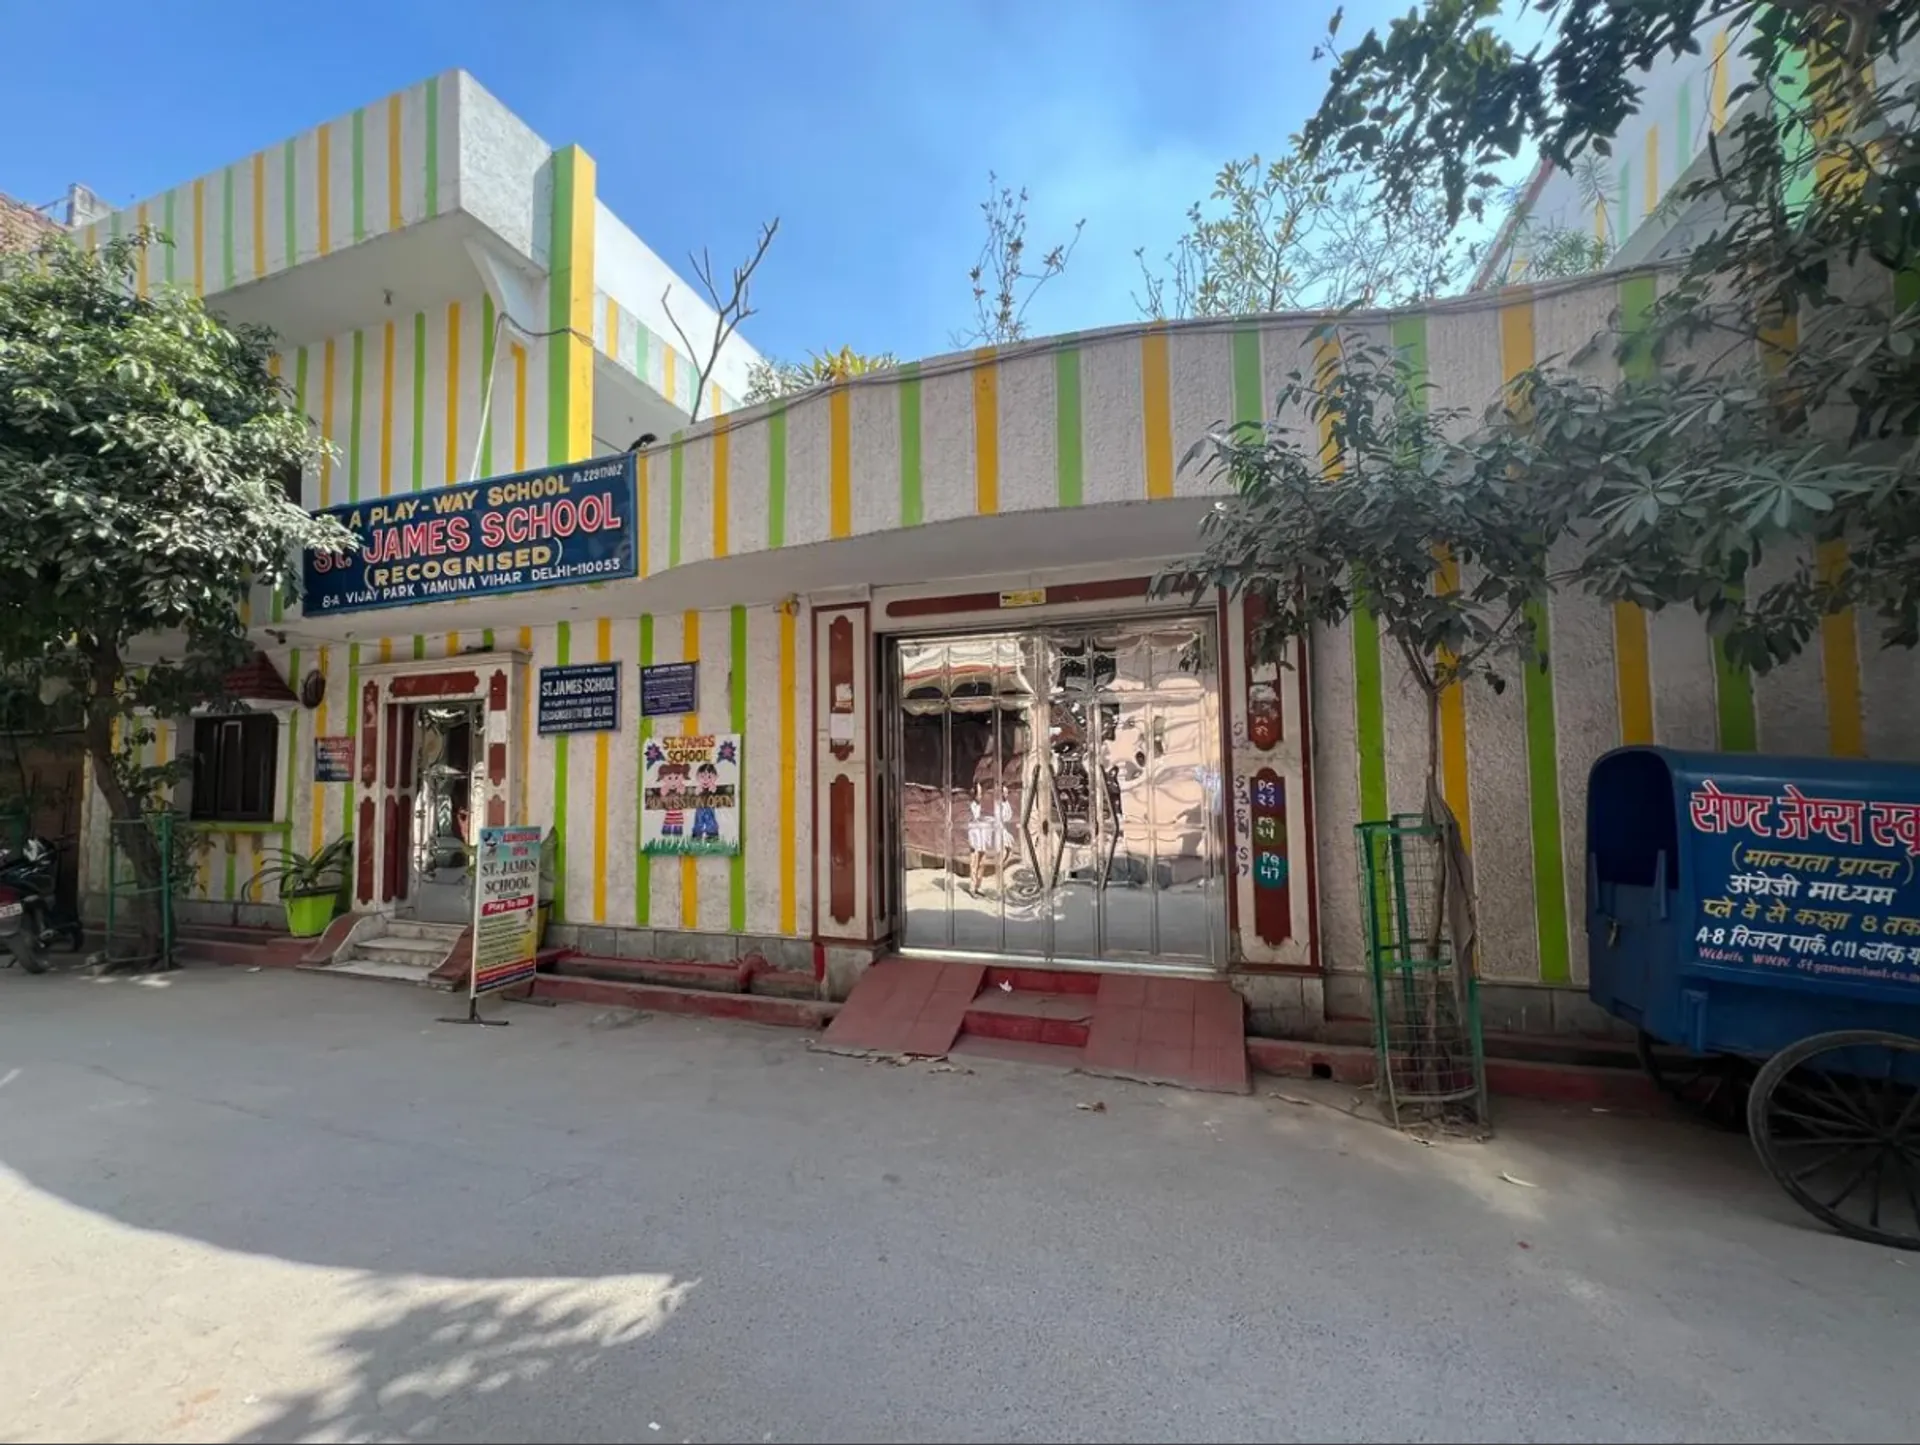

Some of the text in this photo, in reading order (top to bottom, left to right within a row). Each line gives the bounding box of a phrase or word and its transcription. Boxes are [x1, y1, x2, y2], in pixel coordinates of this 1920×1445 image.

[349, 509, 363, 528] A
[487, 474, 571, 507] SCHOOL
[362, 516, 471, 564] JAMES
[480, 491, 622, 548] SCHOOL
[363, 537, 563, 591] (RECOGNISED)
[346, 589, 380, 604] VIJAY
[383, 583, 415, 600] PARK
[422, 576, 476, 595] YAMUNA
[480, 571, 523, 587] VIHAR
[531, 557, 621, 582] DELHI-110053
[584, 676, 616, 694] SCHOOL
[667, 749, 711, 763] SCHOOL
[1257, 779, 1275, 794] PS
[1690, 779, 1773, 838] सेण्ट
[1777, 784, 1865, 845] जेम्स
[501, 859, 537, 876] JAMES
[1260, 865, 1280, 880] 47
[484, 876, 531, 895] SCHOOL
[1726, 871, 1897, 906] अंग्रेजी माध्यम
[1703, 896, 1738, 919] प्ले
[1765, 899, 1790, 924] से
[1794, 908, 1852, 932] कक्षा
[1861, 915, 1878, 933] 8
[1695, 926, 1726, 945] A-8
[1729, 924, 1788, 952] विजय
